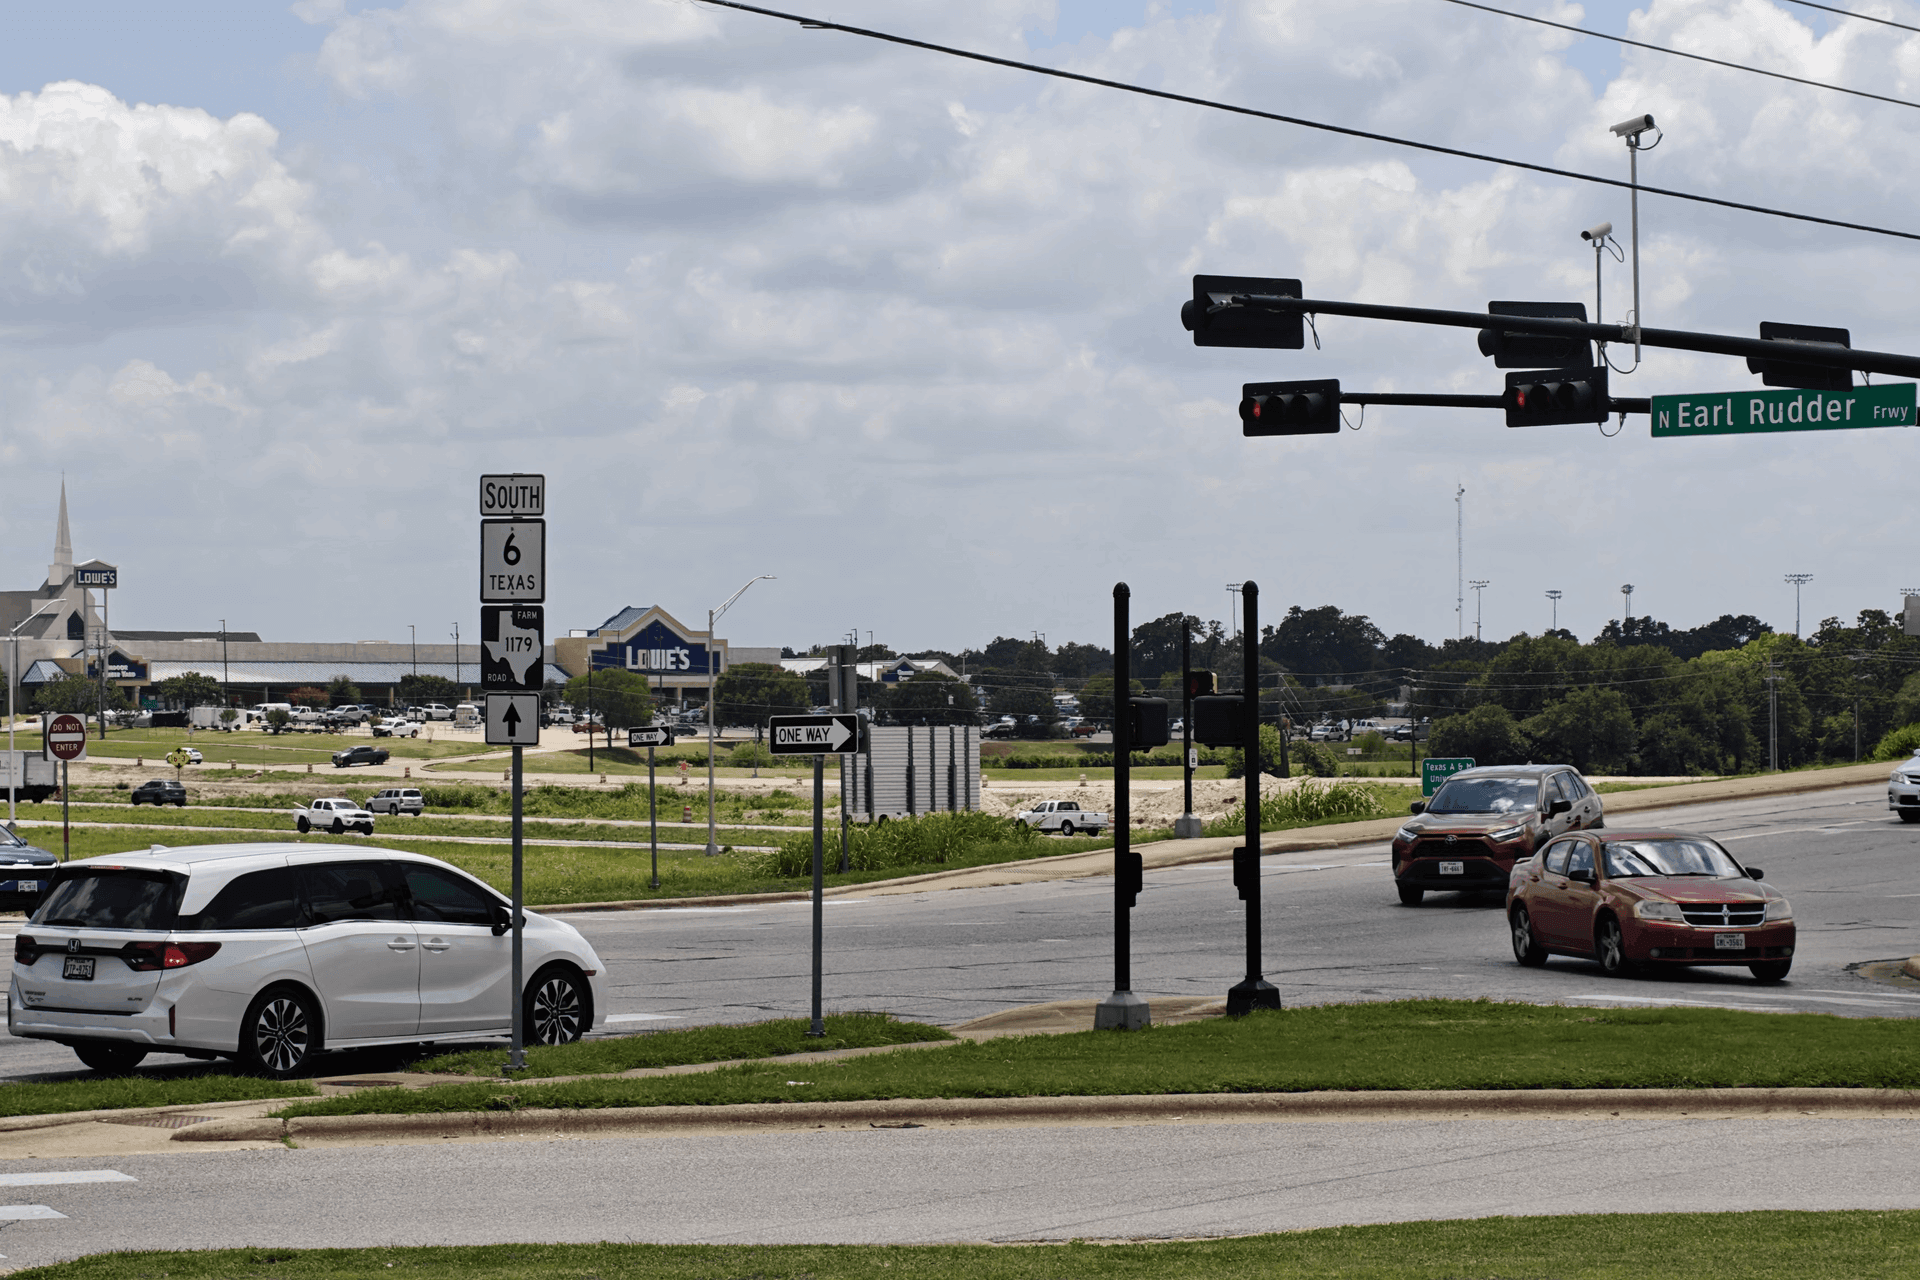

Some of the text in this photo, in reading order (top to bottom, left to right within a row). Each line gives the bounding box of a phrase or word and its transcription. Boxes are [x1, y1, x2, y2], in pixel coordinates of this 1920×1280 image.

[1659, 394, 1909, 429] N Earl Rudder Frwy
[485, 482, 540, 509] SOUTH
[503, 532, 521, 566] 6
[78, 570, 115, 584] LOWE'S
[489, 574, 535, 590] TEXAS
[517, 611, 537, 619] FARM
[505, 637, 532, 652] 1179
[625, 645, 690, 670] LOWE'S
[487, 673, 507, 682] ROAD
[53, 723, 80, 731] DO NOT
[778, 726, 831, 742] ONE WAY
[632, 731, 658, 742] ONE WAY
[55, 743, 79, 752] ENTER
[1426, 763, 1446, 771] Texas
